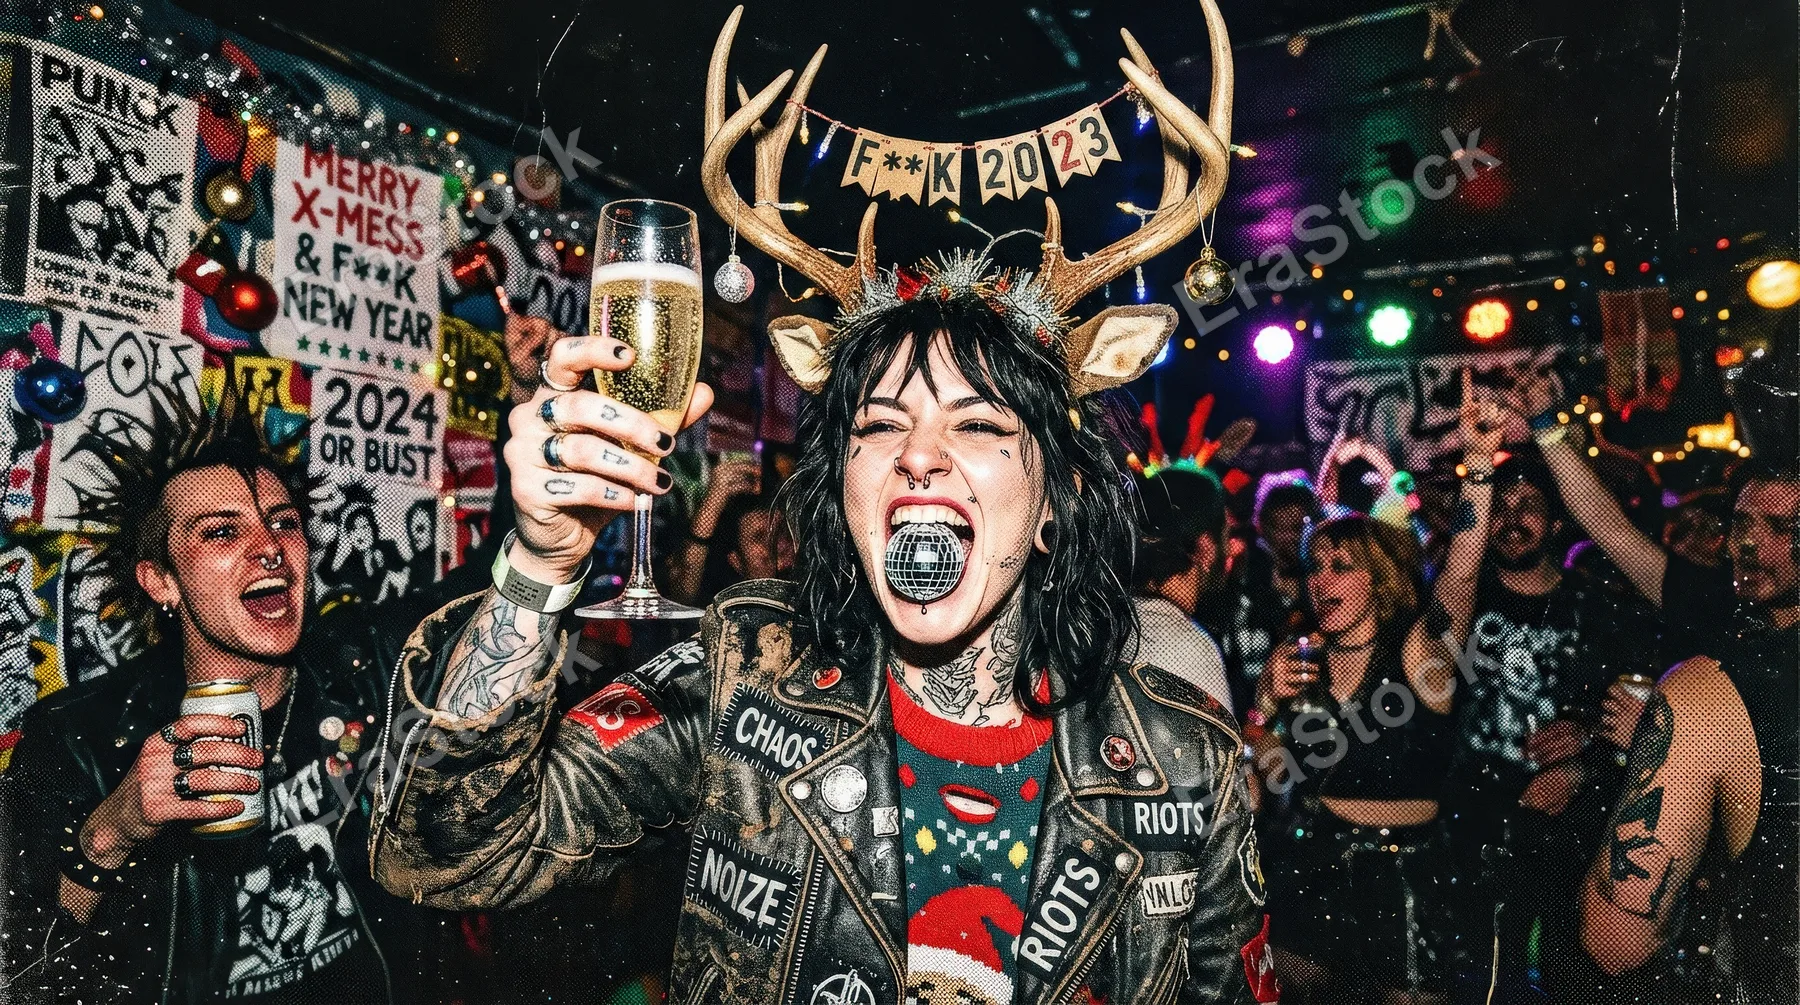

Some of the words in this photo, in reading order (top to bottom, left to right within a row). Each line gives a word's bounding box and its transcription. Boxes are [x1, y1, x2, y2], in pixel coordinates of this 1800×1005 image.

[303, 142, 421, 213] MERRY
[982, 116, 1109, 190] 2023
[291, 181, 425, 262] X-MESS
[295, 233, 321, 276] &
[283, 277, 357, 332] NEW
[365, 297, 433, 351] YEAR
[324, 376, 438, 441] 2024
[319, 433, 355, 468] OR
[364, 437, 437, 481] BUST
[734, 706, 818, 770] CHAOS
[1133, 801, 1204, 836] RIOTS
[700, 847, 788, 928] NOIZE
[1019, 857, 1101, 973] RIOTS
